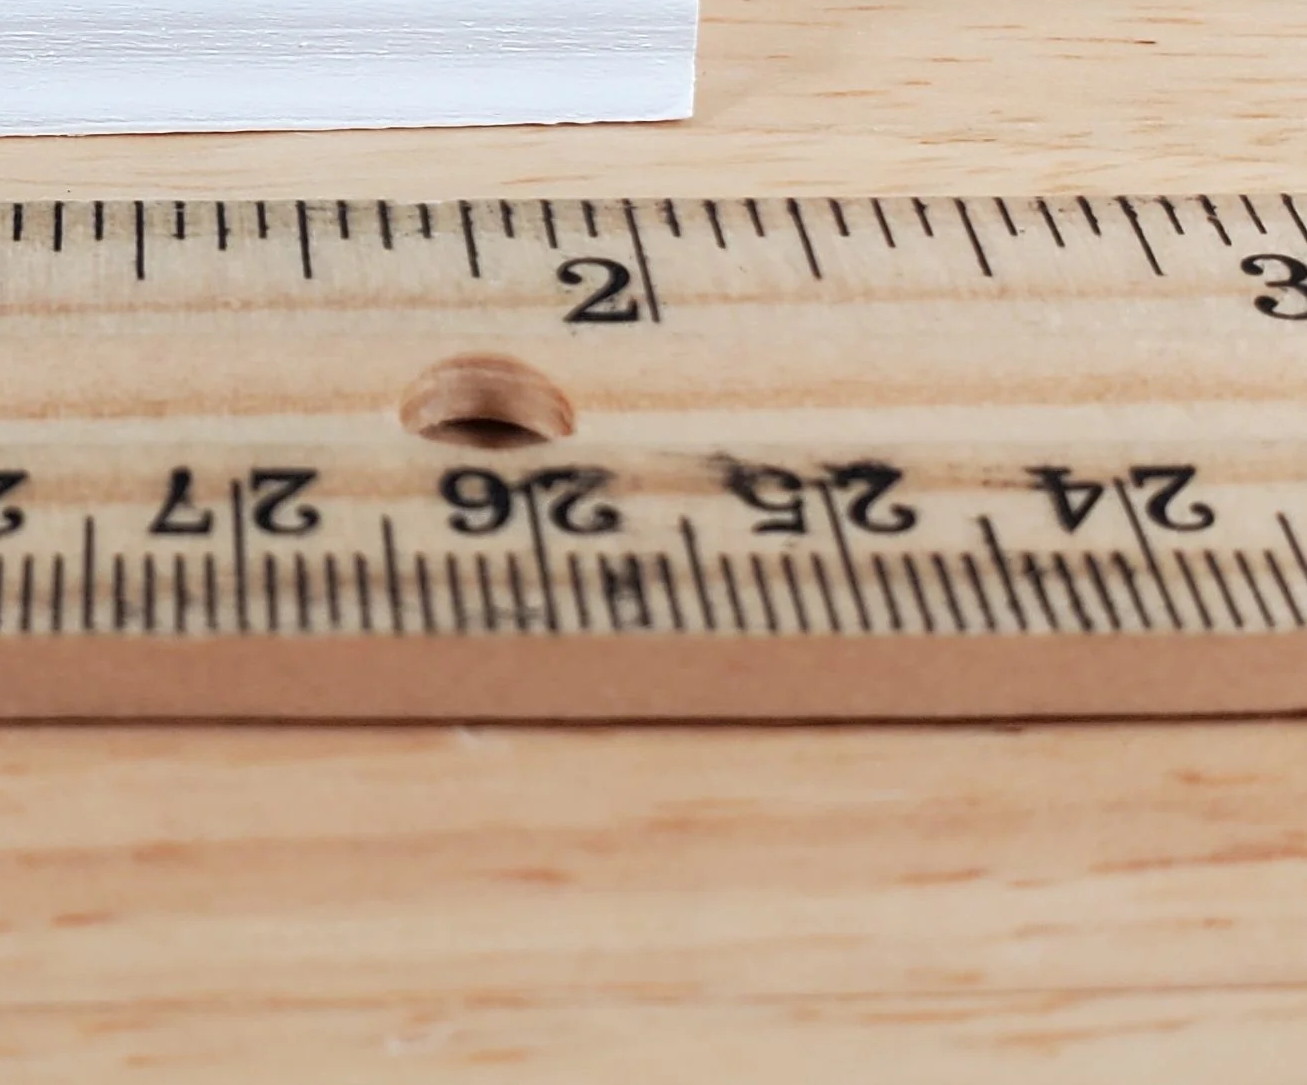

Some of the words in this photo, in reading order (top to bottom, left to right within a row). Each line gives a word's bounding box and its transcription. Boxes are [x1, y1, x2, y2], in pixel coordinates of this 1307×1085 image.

[556, 257, 641, 323] 2
[1240, 254, 1307, 320] 3
[150, 466, 323, 536] 27
[438, 465, 624, 536] 26
[722, 460, 918, 536] 25
[1023, 464, 1216, 534] 24
